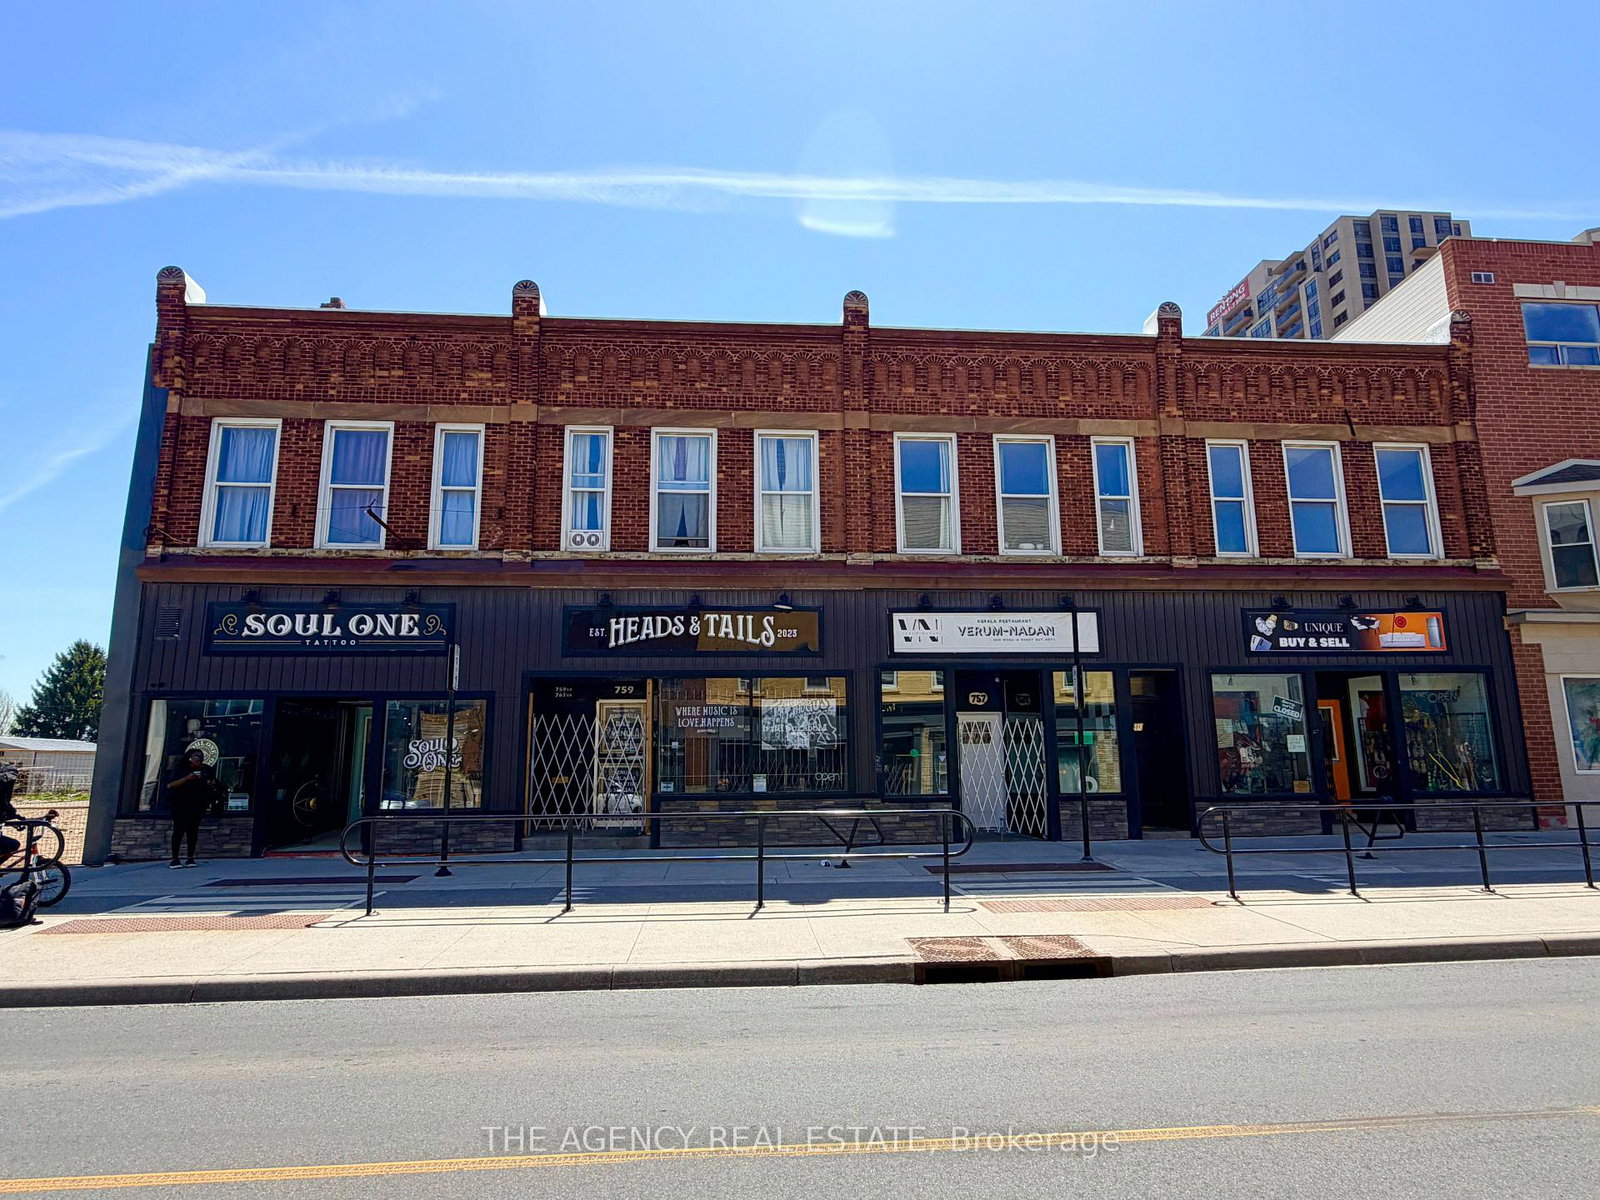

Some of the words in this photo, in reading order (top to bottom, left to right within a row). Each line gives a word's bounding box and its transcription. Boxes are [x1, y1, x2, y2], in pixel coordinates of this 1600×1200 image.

[241, 613, 342, 637] SOUL
[348, 613, 420, 636] ONE
[1304, 623, 1344, 634] UNIQUE
[589, 627, 607, 637] EST.
[608, 616, 685, 648] HEADS
[688, 617, 701, 636] &
[703, 614, 775, 648] TAILS
[957, 626, 1055, 637] VERUM-NADAN
[1279, 637, 1306, 648] BUY
[1308, 637, 1319, 648] &
[1319, 637, 1350, 648] SELL
[614, 686, 634, 694] 759
[970, 694, 986, 703] 757
[675, 707, 701, 717] WHERE
[702, 706, 728, 717] MUSIC
[729, 706, 738, 716] IS
[1273, 705, 1300, 718] CLOSED
